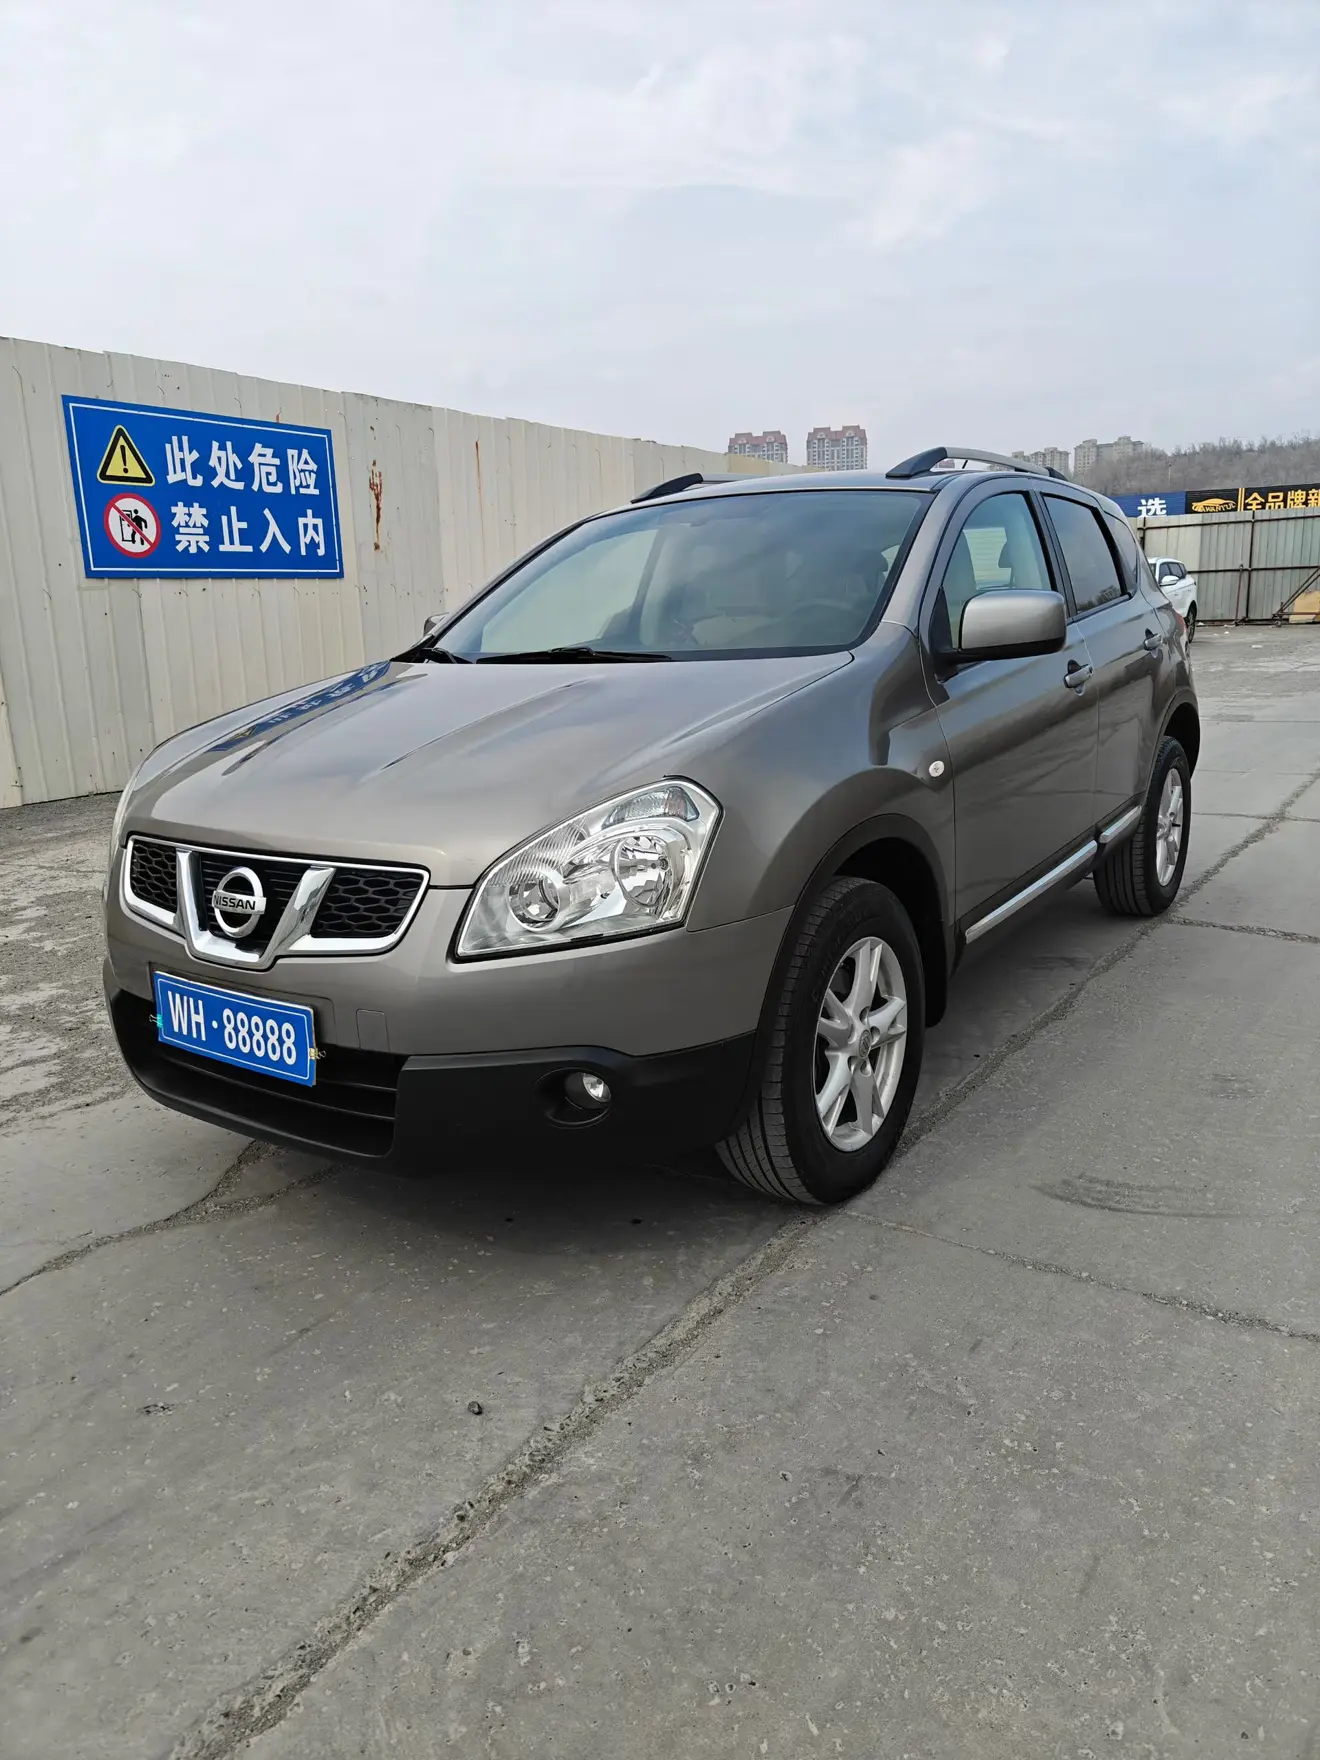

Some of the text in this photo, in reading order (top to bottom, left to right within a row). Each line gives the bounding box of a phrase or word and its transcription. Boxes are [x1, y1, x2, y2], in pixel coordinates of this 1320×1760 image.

[165, 435, 320, 495] 此处危险
[1137, 497, 1167, 518] 选
[171, 501, 326, 556] 禁止入内
[213, 894, 257, 911] NISSAN
